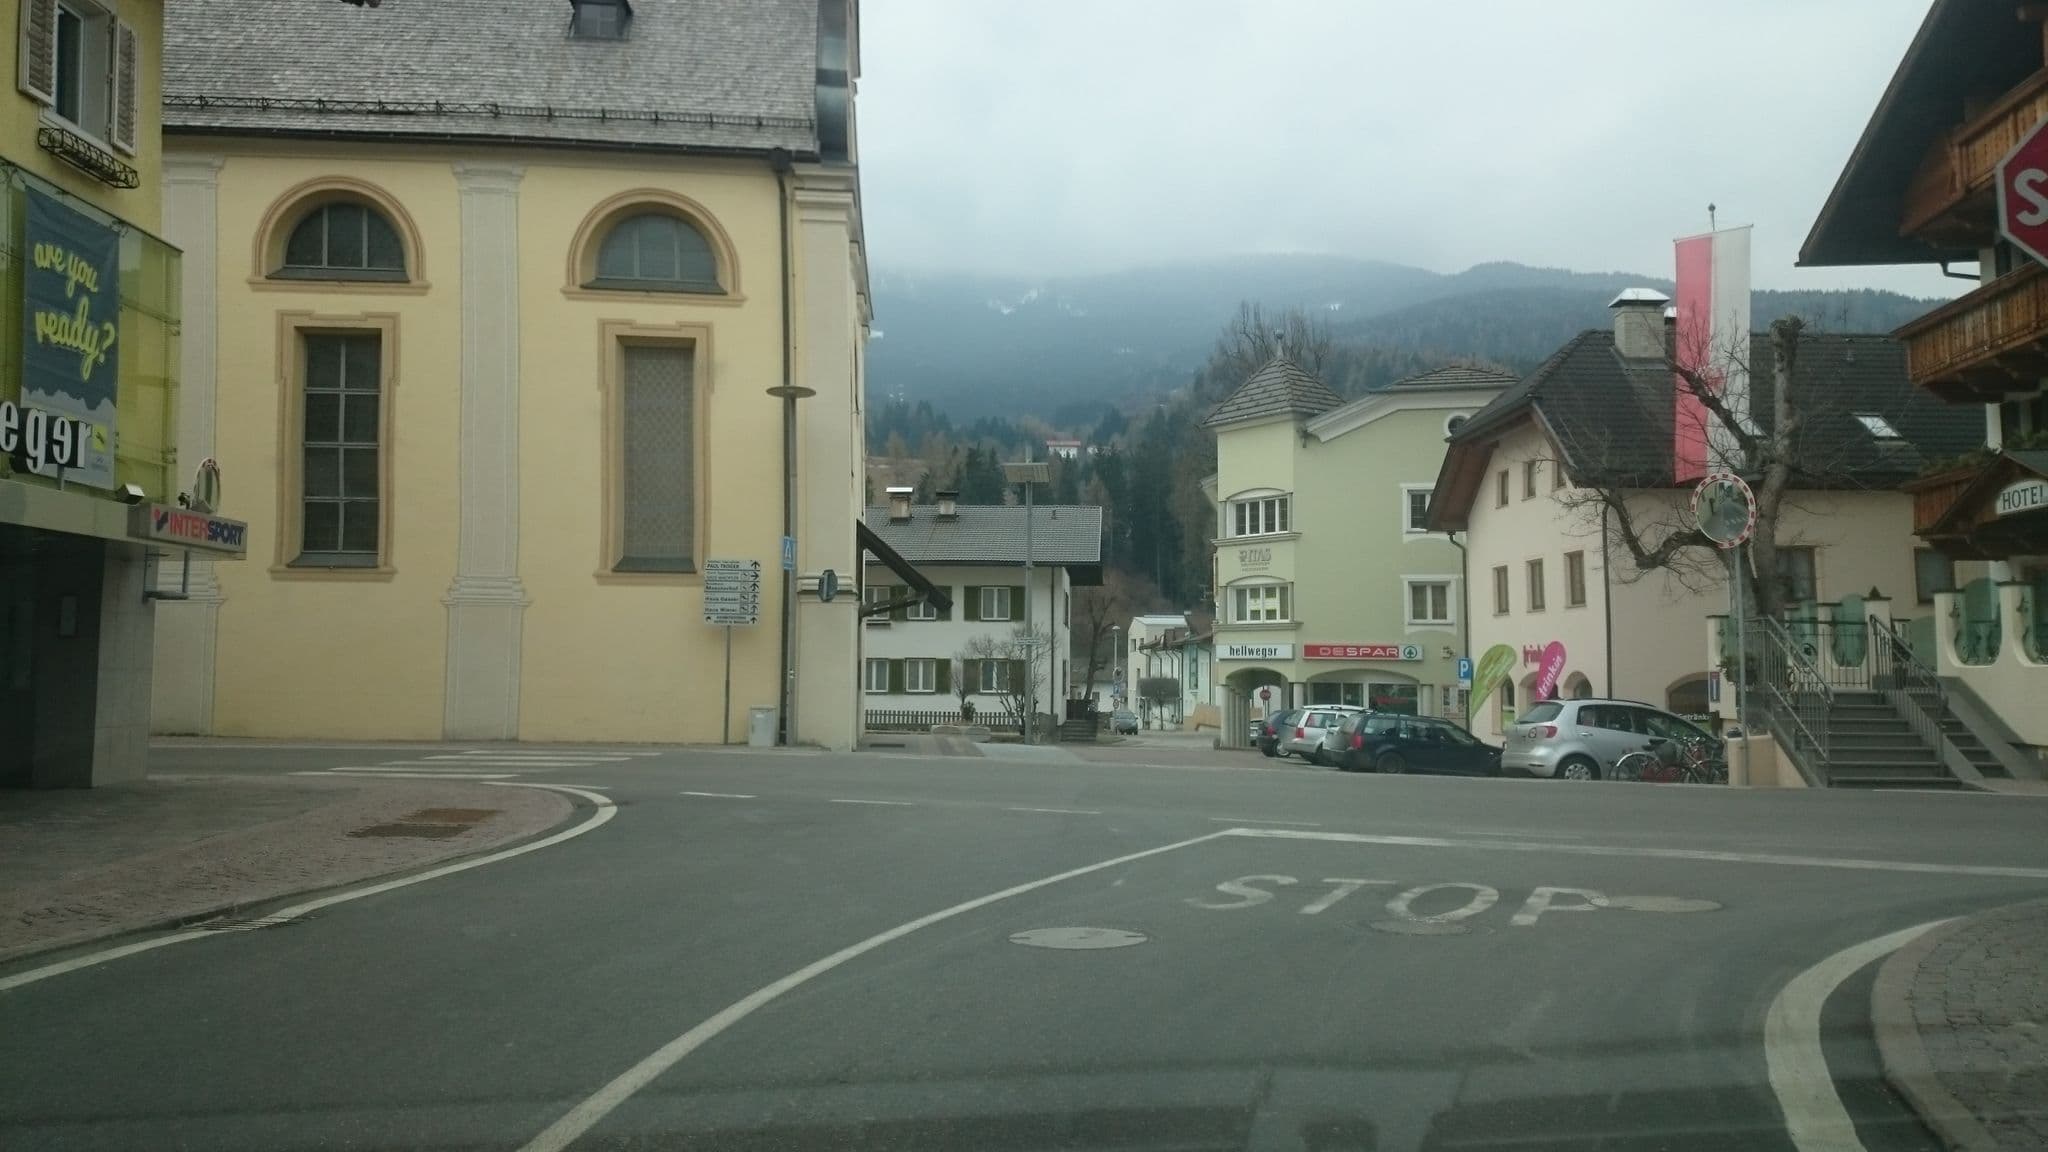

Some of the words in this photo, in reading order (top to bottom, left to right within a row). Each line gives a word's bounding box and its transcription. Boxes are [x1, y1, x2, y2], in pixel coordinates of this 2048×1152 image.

[34, 241, 64, 271] are
[67, 252, 98, 298] you
[35, 296, 115, 381] ready?
[170, 513, 245, 547] INTERSPORT
[1229, 645, 1278, 658] hellweger
[1319, 647, 1398, 657] DESPAR
[1460, 660, 1469, 677] P
[1186, 875, 1607, 927] STOP
